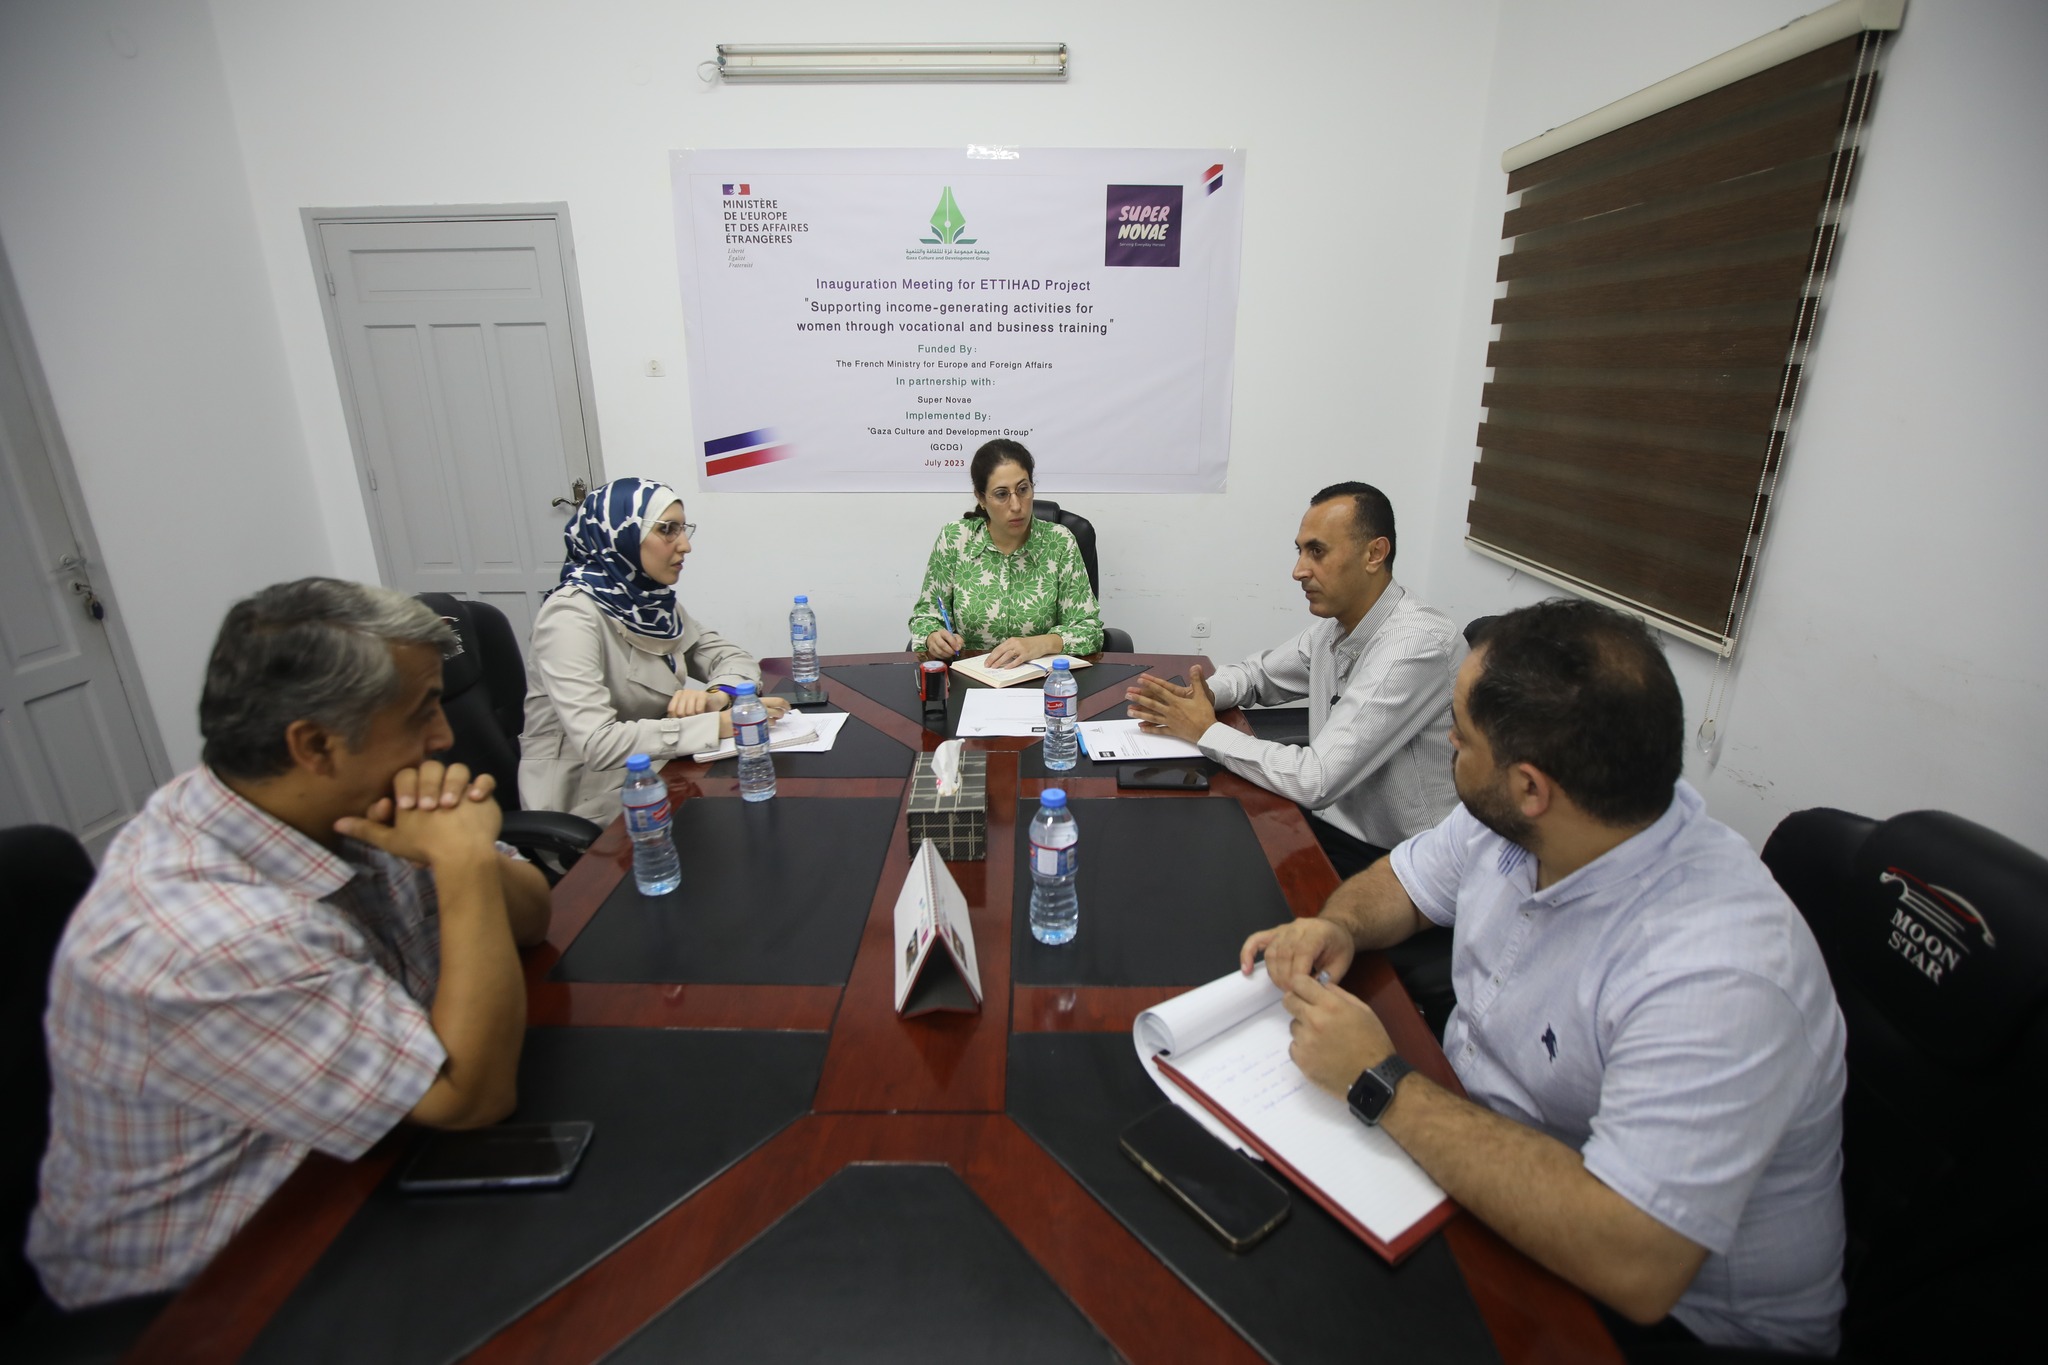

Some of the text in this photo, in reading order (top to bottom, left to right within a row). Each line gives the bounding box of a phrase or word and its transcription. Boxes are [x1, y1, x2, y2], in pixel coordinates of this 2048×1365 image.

[723, 198, 778, 209] MINISTÈRE
[724, 211, 738, 221] DE
[1118, 205, 1171, 222] SUPER
[725, 223, 809, 233] ET DES AFFAIRES
[1117, 223, 1170, 240] NOVAE
[726, 233, 793, 244] ÉTRANGÈRES
[816, 278, 1091, 293] Inauguration Meeting for ETTIHAD Project
[886, 301, 1009, 315] income-generating
[1013, 302, 1072, 313] activities
[1076, 302, 1094, 313] for
[796, 322, 841, 332] women
[845, 320, 894, 334] through
[899, 321, 965, 332] vocational
[969, 322, 993, 332] and
[997, 322, 1055, 333] business
[917, 344, 956, 354] Funded
[835, 360, 852, 368] The
[854, 360, 885, 368] French
[887, 360, 921, 370] Ministry
[937, 361, 969, 370] Europe
[971, 361, 987, 369] and
[989, 361, 1022, 371] Foreign
[1024, 361, 1053, 369] Affairs
[896, 376, 906, 386] In
[908, 378, 968, 388] partnership
[917, 396, 972, 405] Super Novae
[905, 411, 971, 422] Implemented
[894, 427, 926, 436] Culture
[927, 428, 943, 436] and
[945, 428, 1001, 437] Development
[930, 443, 963, 452] (GCDG)
[924, 459, 965, 468] July 2023
[1889, 907, 1961, 971] MOON
[1887, 930, 1943, 986] STAR
